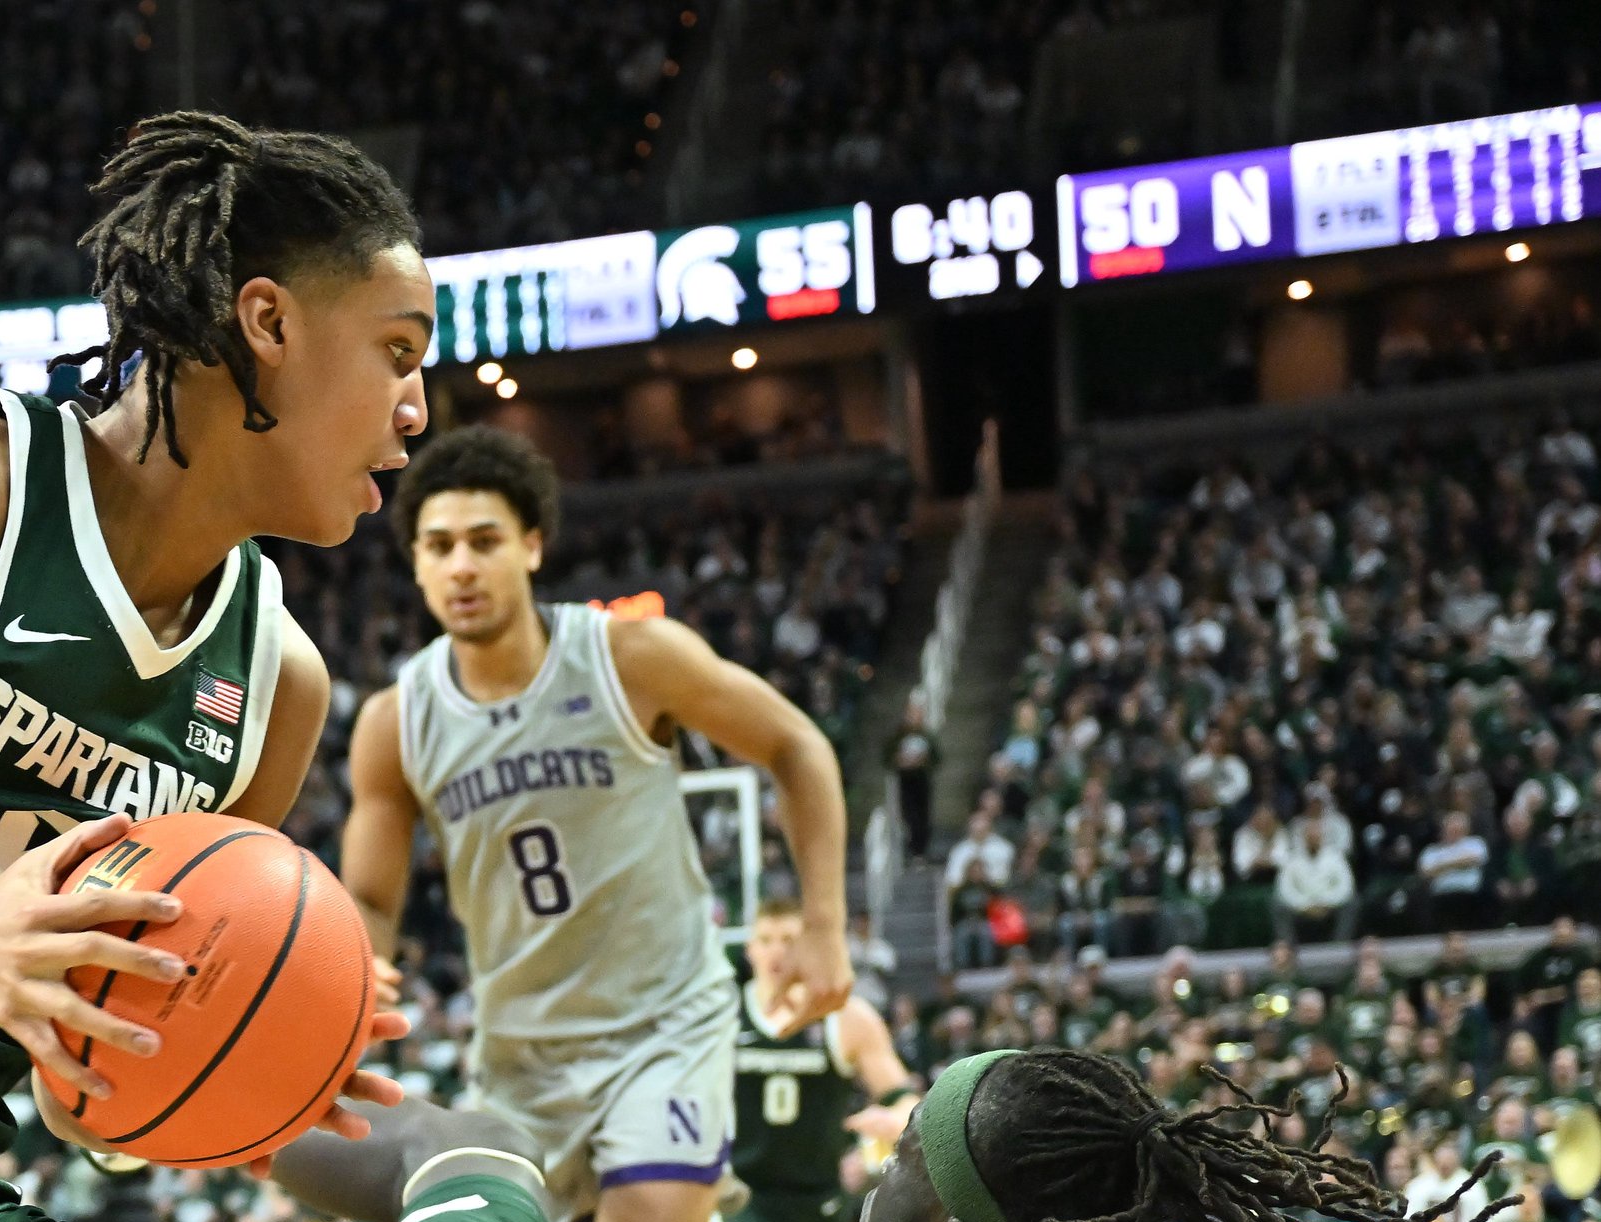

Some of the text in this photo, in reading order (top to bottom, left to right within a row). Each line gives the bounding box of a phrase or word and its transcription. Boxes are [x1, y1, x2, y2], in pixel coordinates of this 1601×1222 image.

[892, 190, 1034, 265] 6:40
[1081, 177, 1179, 254] 50
[1211, 166, 1272, 252] N
[756, 220, 852, 297] 55
[507, 823, 573, 918] 8
[762, 1073, 799, 1126] 0
